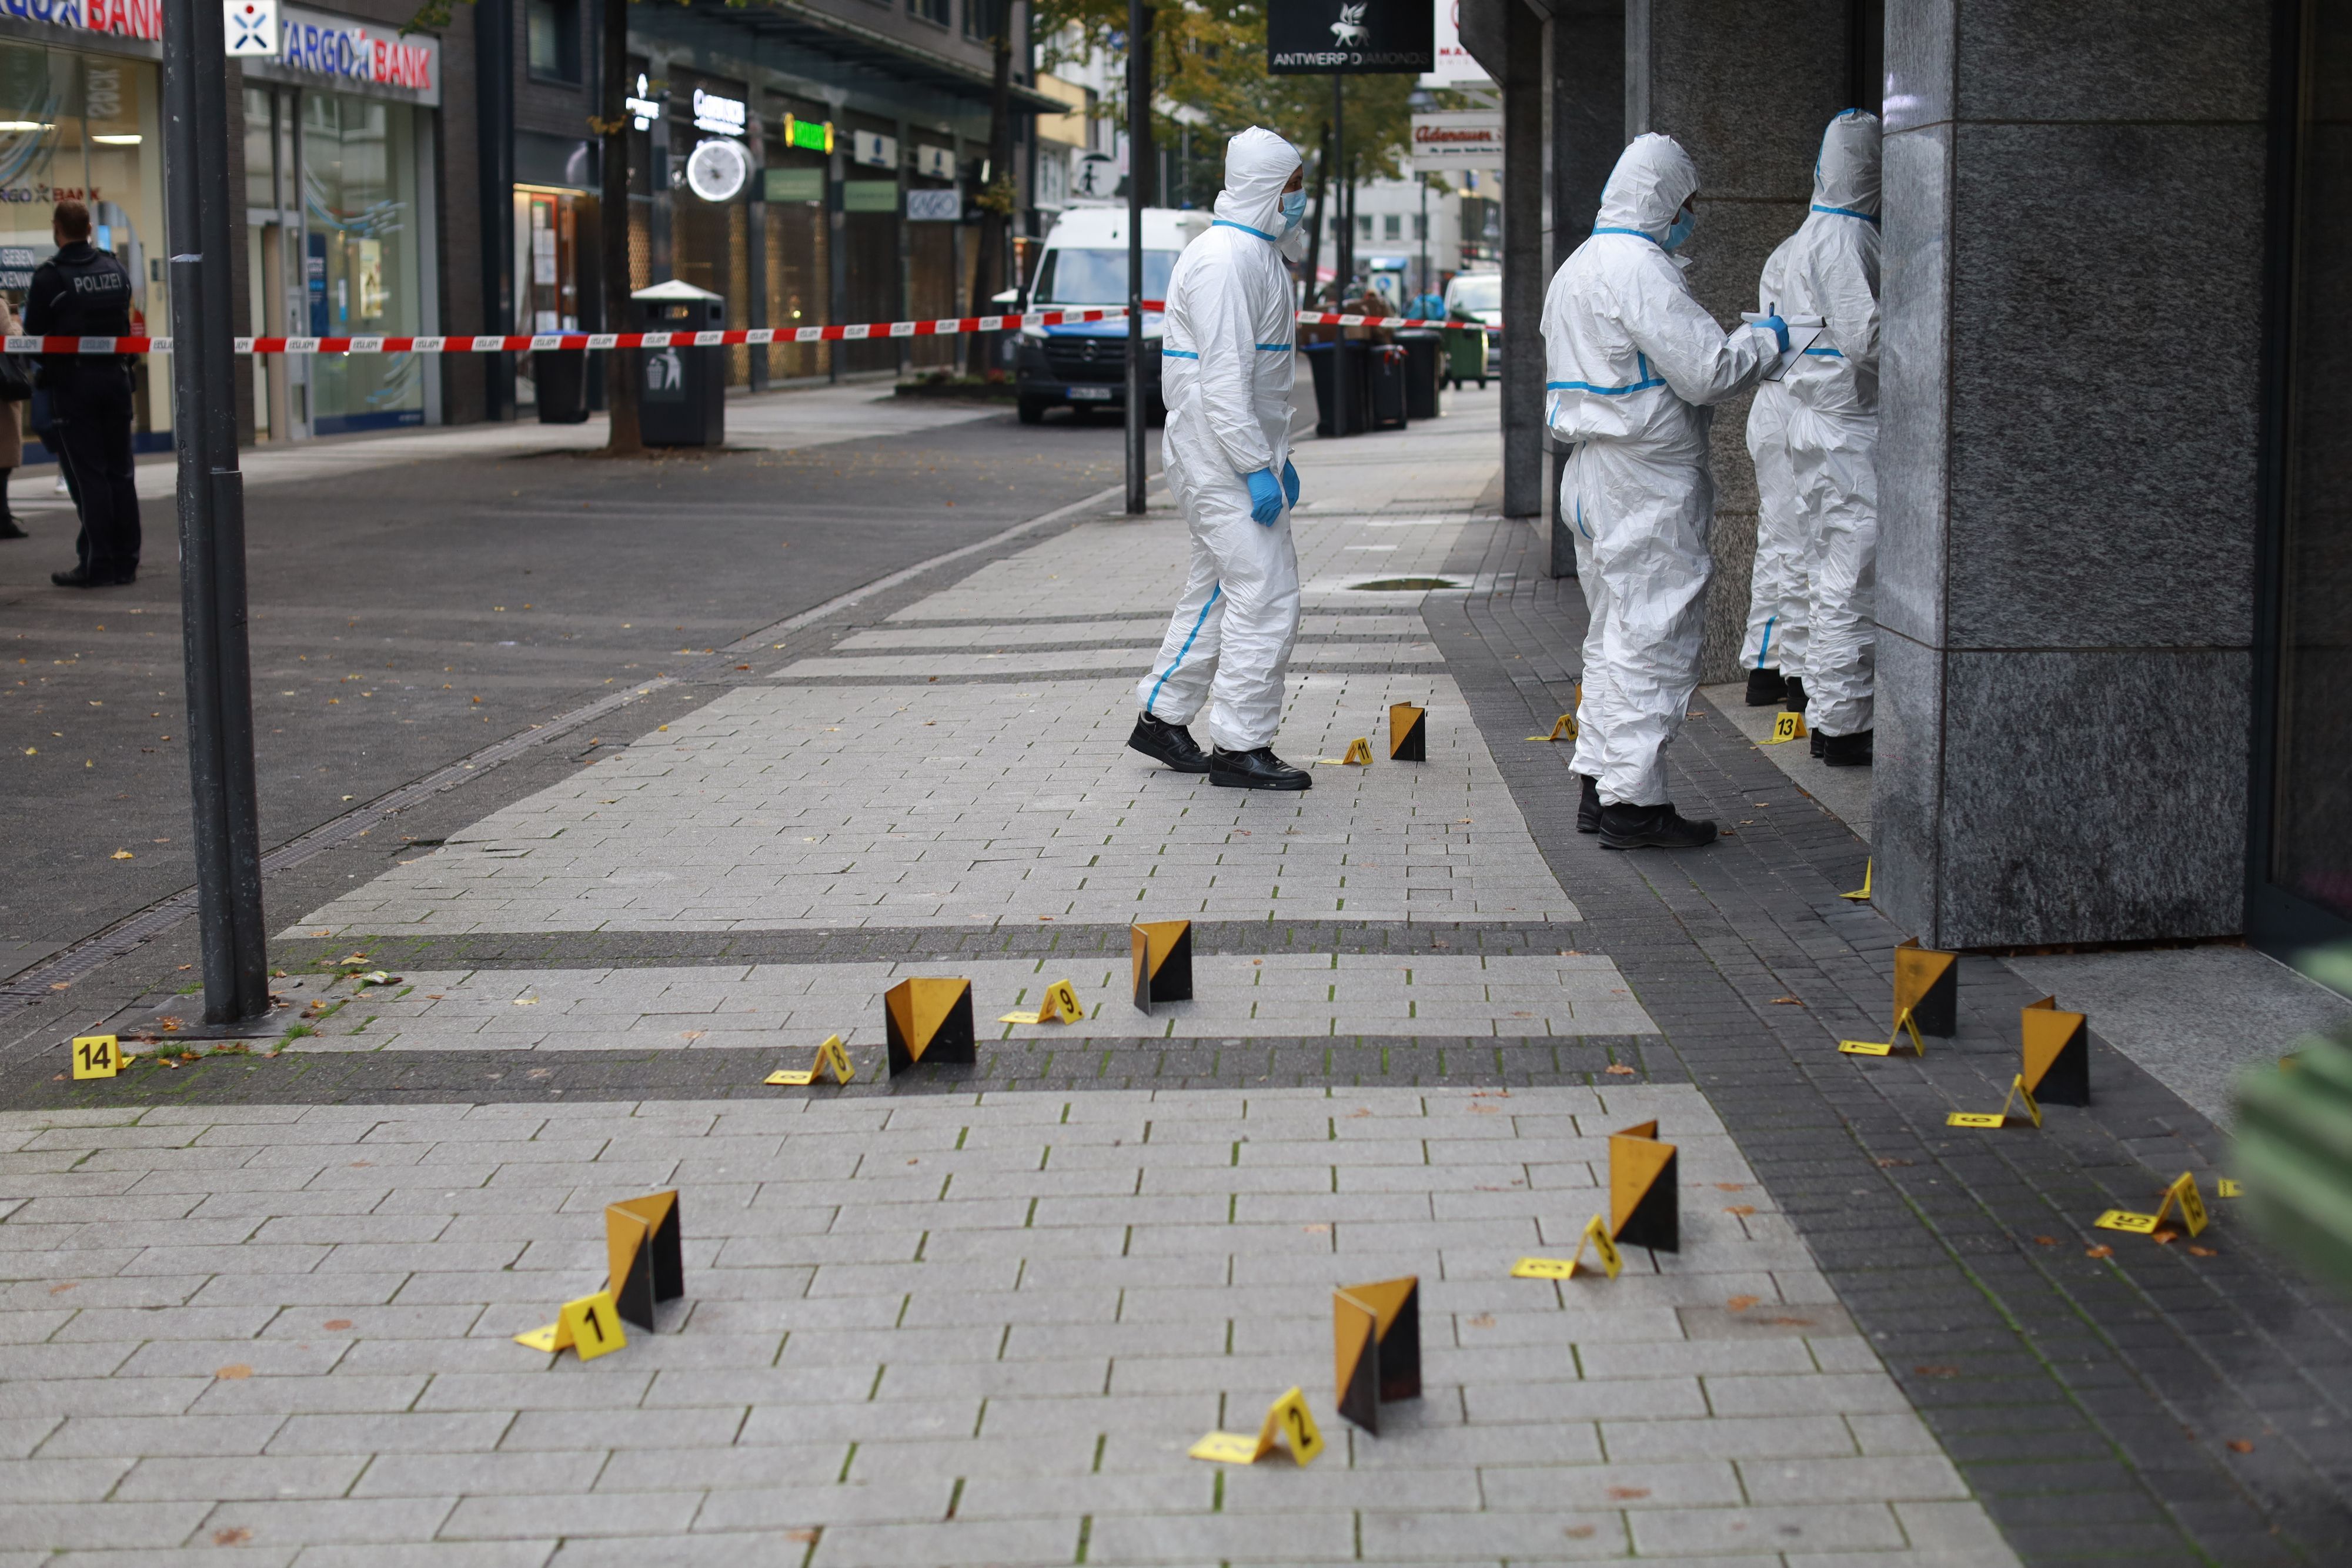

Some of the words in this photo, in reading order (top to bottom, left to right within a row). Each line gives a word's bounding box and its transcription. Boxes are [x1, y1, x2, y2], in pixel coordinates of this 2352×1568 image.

[373, 38, 431, 90] BANK
[1273, 52, 1348, 66] ANTWERP
[1351, 52, 1430, 65] DIAMONDS
[74, 273, 122, 295] POLIZEI
[1565, 718, 1575, 735] 12
[1778, 718, 1794, 736] 13
[1358, 741, 1369, 760] 11
[1060, 988, 1075, 1014] 9
[78, 1042, 111, 1071] 14
[832, 1045, 847, 1072] 8
[2112, 1215, 2151, 1228] 15
[583, 1306, 604, 1343] 1
[1288, 1406, 1312, 1447] 2
